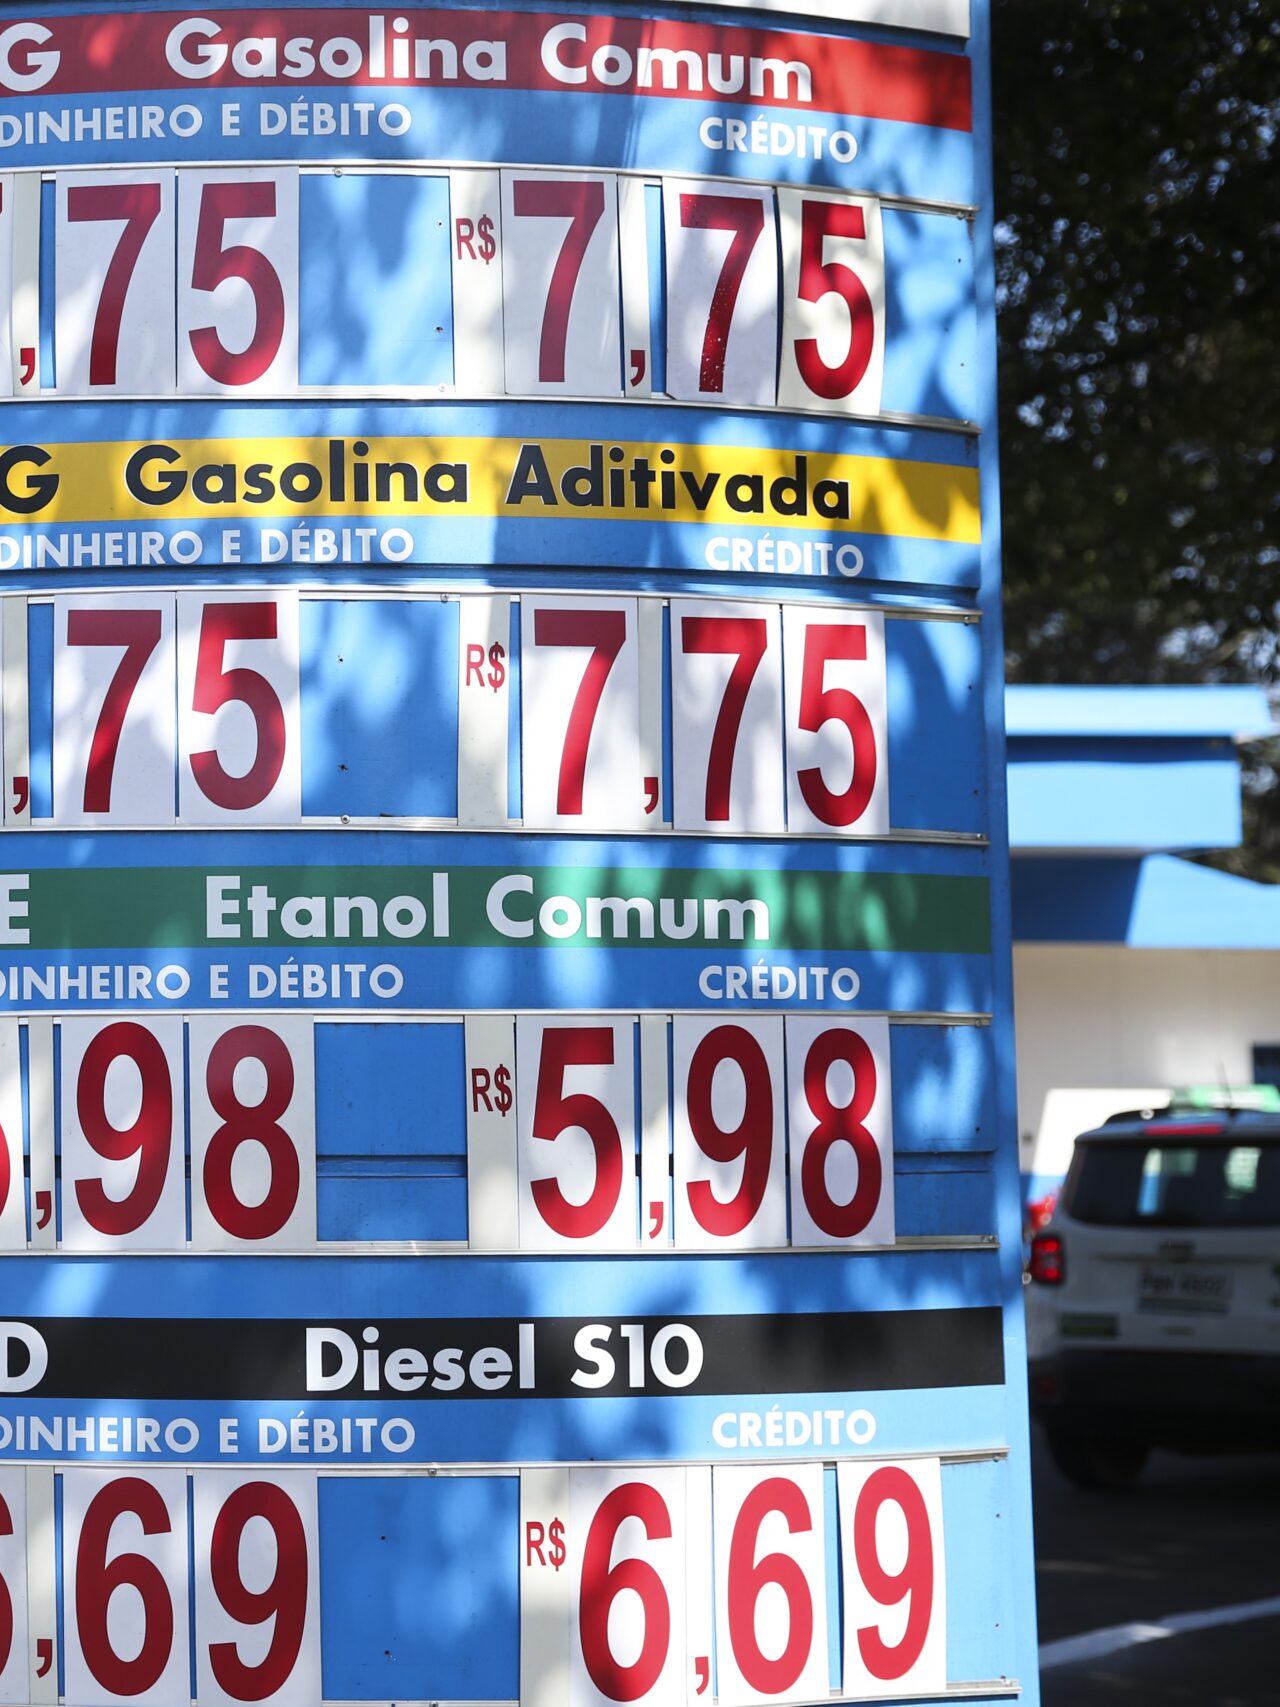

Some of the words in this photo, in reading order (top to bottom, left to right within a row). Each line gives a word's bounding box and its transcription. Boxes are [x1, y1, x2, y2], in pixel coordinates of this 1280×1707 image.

[165, 15, 507, 81] Gasolina
[540, 22, 813, 103] Comum
[222, 103, 241, 136] E
[260, 95, 412, 137] DÉBITO
[699, 114, 858, 164] CRÉDITO
[456, 213, 496, 266] R$
[513, 181, 873, 400] 7,75
[125, 439, 469, 506] Gasolina
[505, 443, 851, 520] Aditivada
[222, 531, 241, 562] E
[261, 521, 415, 563] DÉBITO
[704, 532, 864, 577] CRÉDITO
[466, 641, 506, 694] R$
[533, 609, 876, 829] 7,75
[206, 872, 450, 939] Etanol
[485, 874, 770, 940] Comum
[210, 964, 229, 999] E
[248, 956, 404, 999] DÉBITO
[698, 958, 860, 1001] CRÉDITO
[471, 1063, 513, 1119] R$
[530, 1024, 883, 1240] 5,98
[306, 1323, 535, 1392] Diesel
[570, 1323, 704, 1389] S10
[219, 1418, 239, 1453] E
[258, 1410, 416, 1453] DÉBITO
[712, 1405, 877, 1448] CRÉDITO
[525, 1517, 567, 1572] R$
[579, 1464, 934, 1702] 6,69
